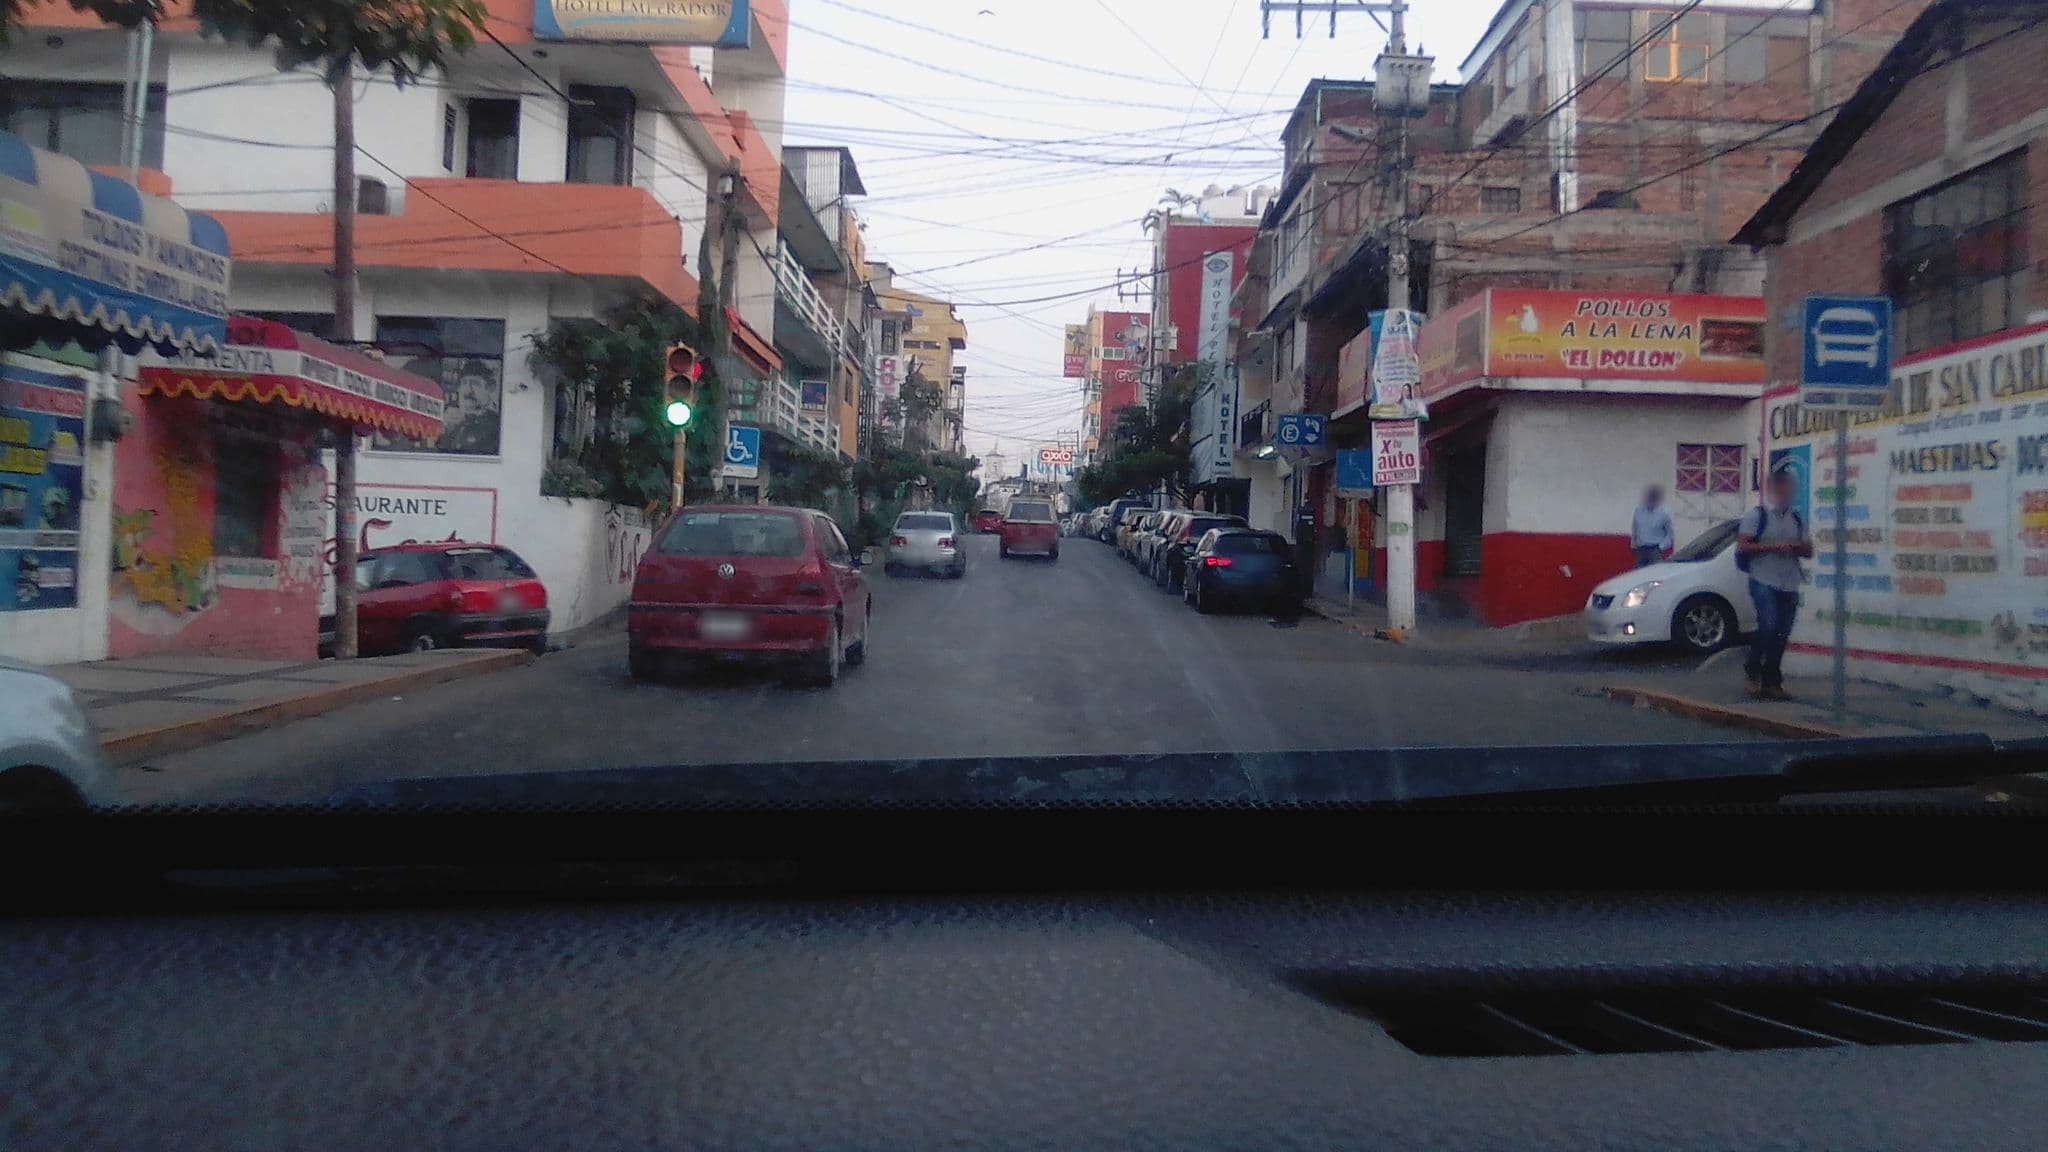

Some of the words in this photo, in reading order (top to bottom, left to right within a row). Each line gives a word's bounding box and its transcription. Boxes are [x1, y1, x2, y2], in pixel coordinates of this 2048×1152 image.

[1577, 300, 1668, 318] POLLOS
[1560, 321, 1576, 337] A
[1589, 322, 1618, 338] LA
[1940, 358, 1981, 407] SAN
[1219, 393, 1230, 458] HOTEL
[1041, 451, 1072, 462] OXXO
[1377, 451, 1415, 470] auto
